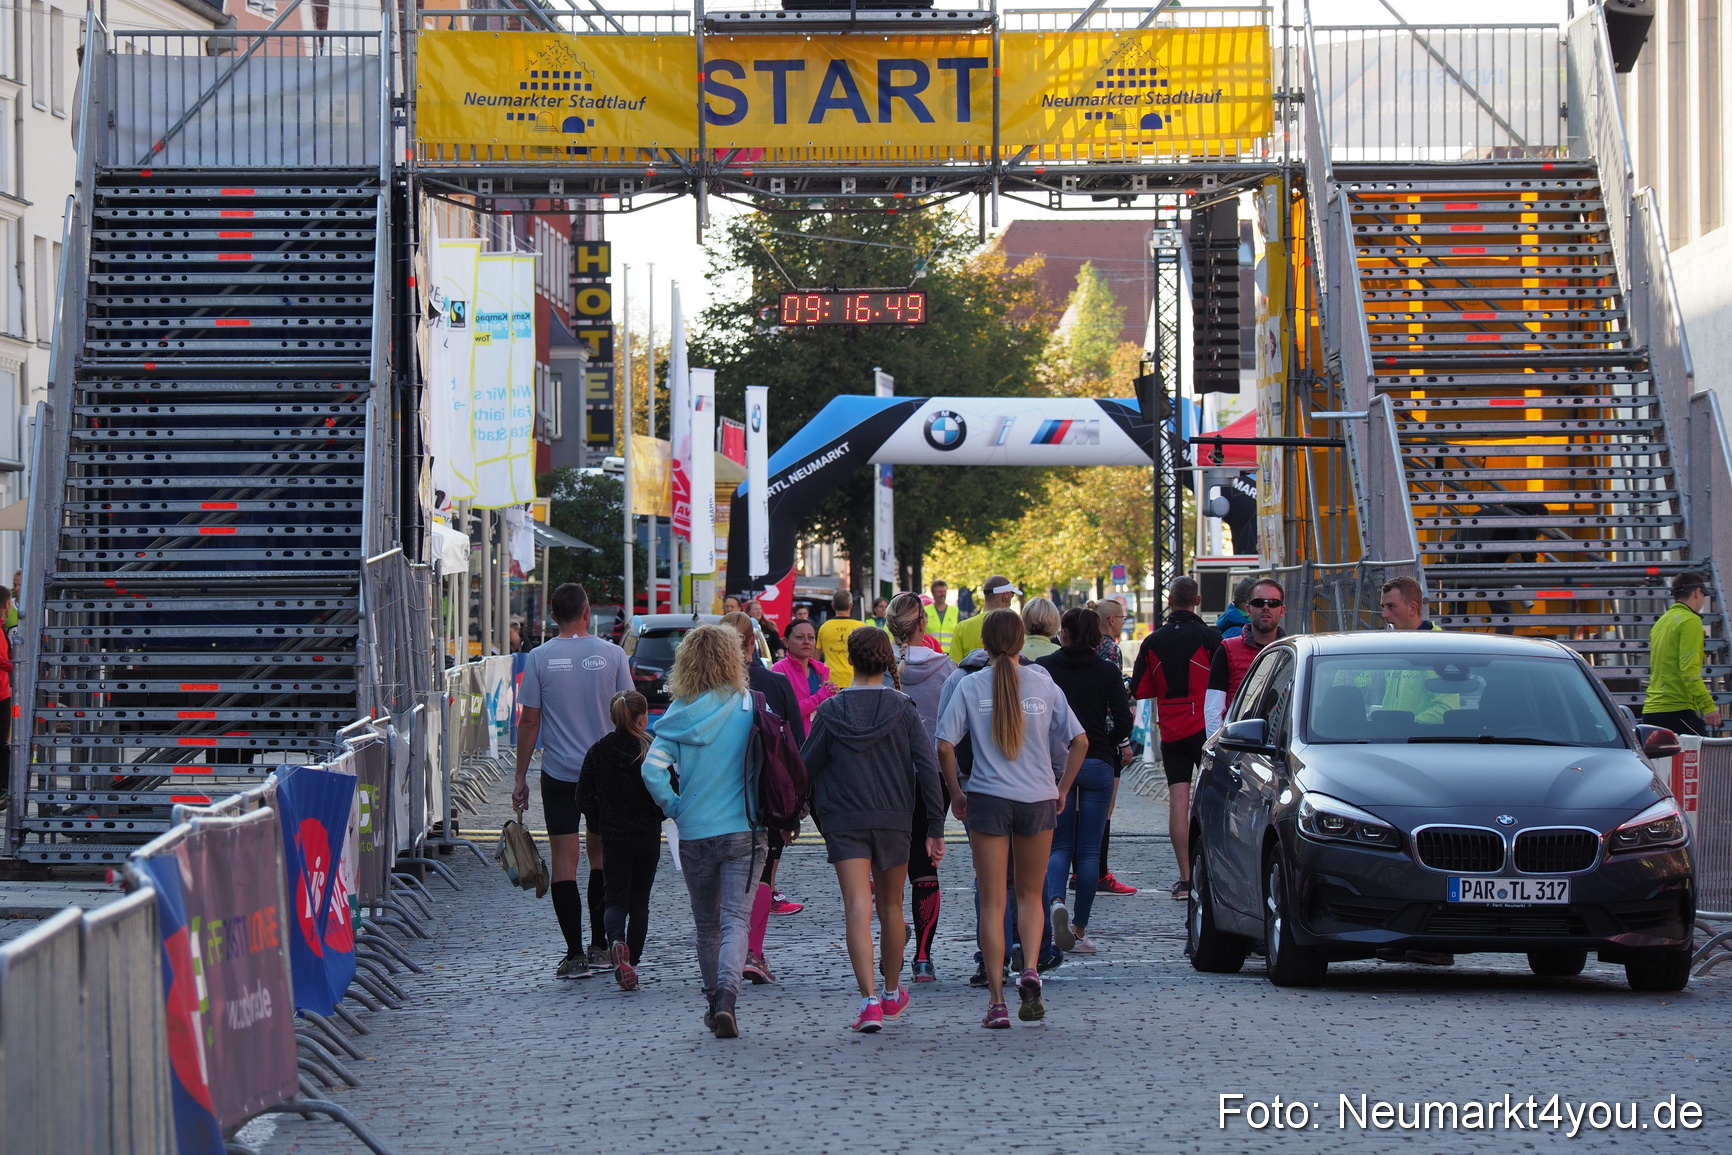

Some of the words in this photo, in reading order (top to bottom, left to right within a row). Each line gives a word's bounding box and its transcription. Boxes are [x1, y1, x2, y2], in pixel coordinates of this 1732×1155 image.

[464, 92, 564, 108] Neumarkter
[568, 94, 647, 111] Stadtlauf
[697, 57, 988, 126] START
[1041, 92, 1140, 108] Neumarkter
[1145, 89, 1222, 105] Stadtlauf
[577, 246, 611, 441] HOTEL
[787, 441, 851, 484] NEUMARKT
[1461, 880, 1495, 899] PAR
[1509, 881, 1531, 900] TL
[1535, 881, 1567, 900] 317
